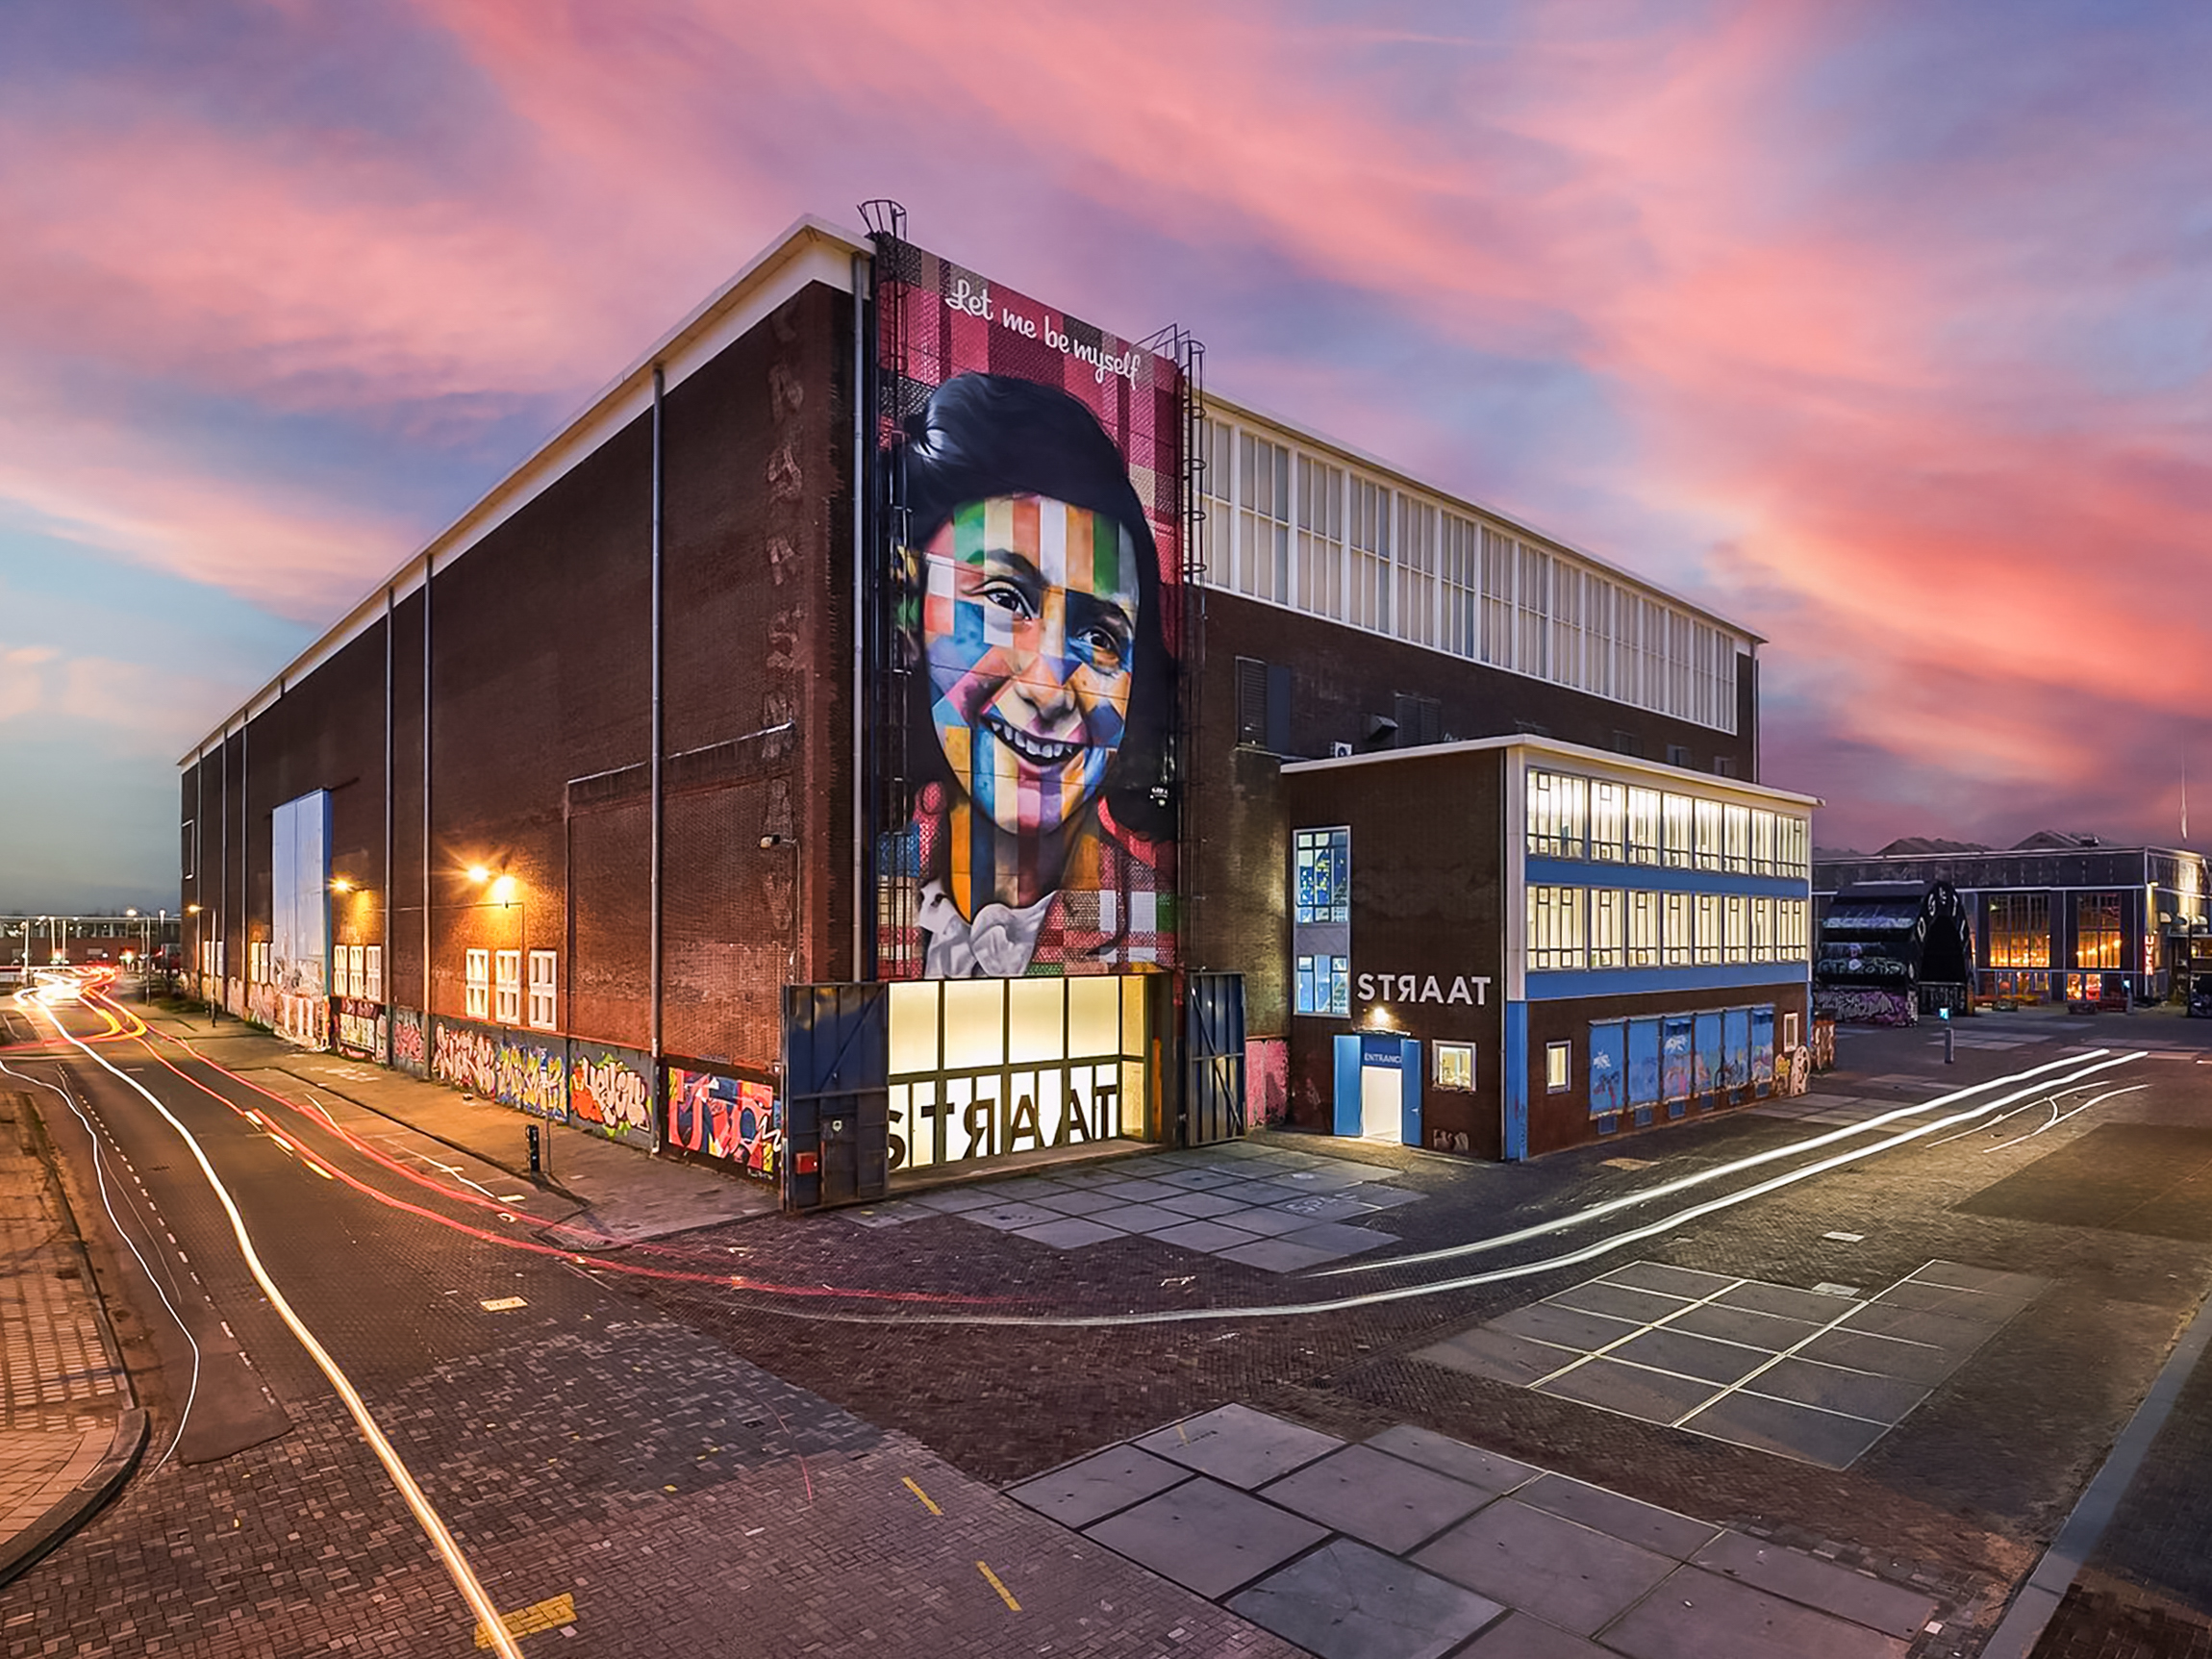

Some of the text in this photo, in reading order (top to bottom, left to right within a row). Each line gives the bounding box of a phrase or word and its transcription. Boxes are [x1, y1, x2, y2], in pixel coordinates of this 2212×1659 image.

[944, 279, 1142, 390] Let me be myself
[1357, 973, 1492, 1005] STRAAT
[1364, 1052, 1402, 1064] ENTRANC
[888, 1084, 1118, 1169] STRAAT
